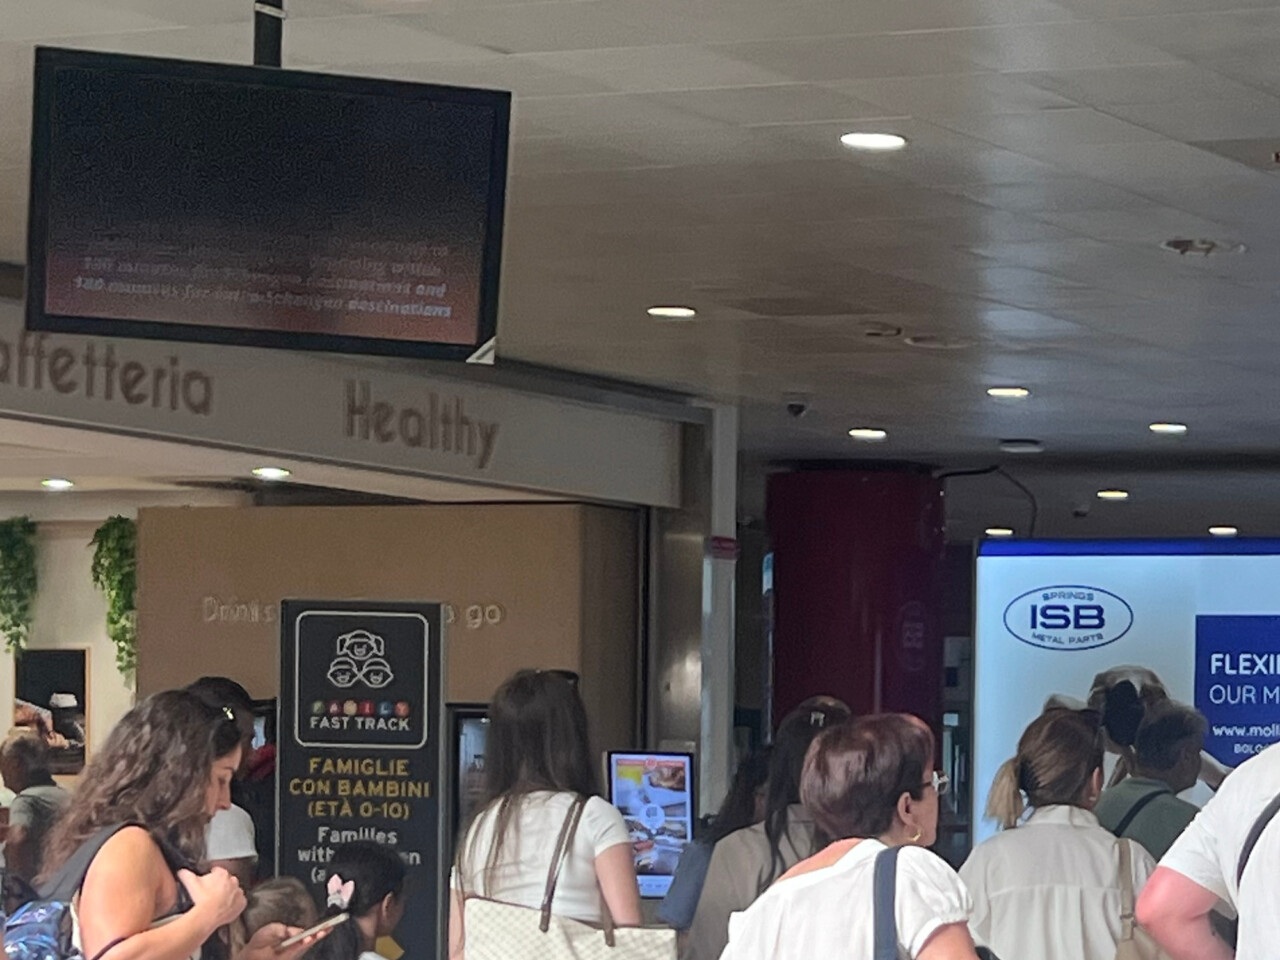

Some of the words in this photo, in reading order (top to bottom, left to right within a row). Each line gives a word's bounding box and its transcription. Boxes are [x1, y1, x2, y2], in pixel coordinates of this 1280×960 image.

[343, 377, 499, 470] Healthy
[465, 604, 502, 629] go
[1030, 604, 1105, 629] ISB
[1209, 684, 1256, 704] OUR
[310, 716, 349, 730] FAST
[355, 717, 410, 731] TRACK
[309, 757, 410, 776] FAMIGLIE
[289, 778, 330, 796] CON
[338, 779, 430, 798] BAMBINI
[307, 797, 353, 818] (ETÀ
[359, 801, 410, 820] 0-10)
[317, 826, 398, 844] Families
